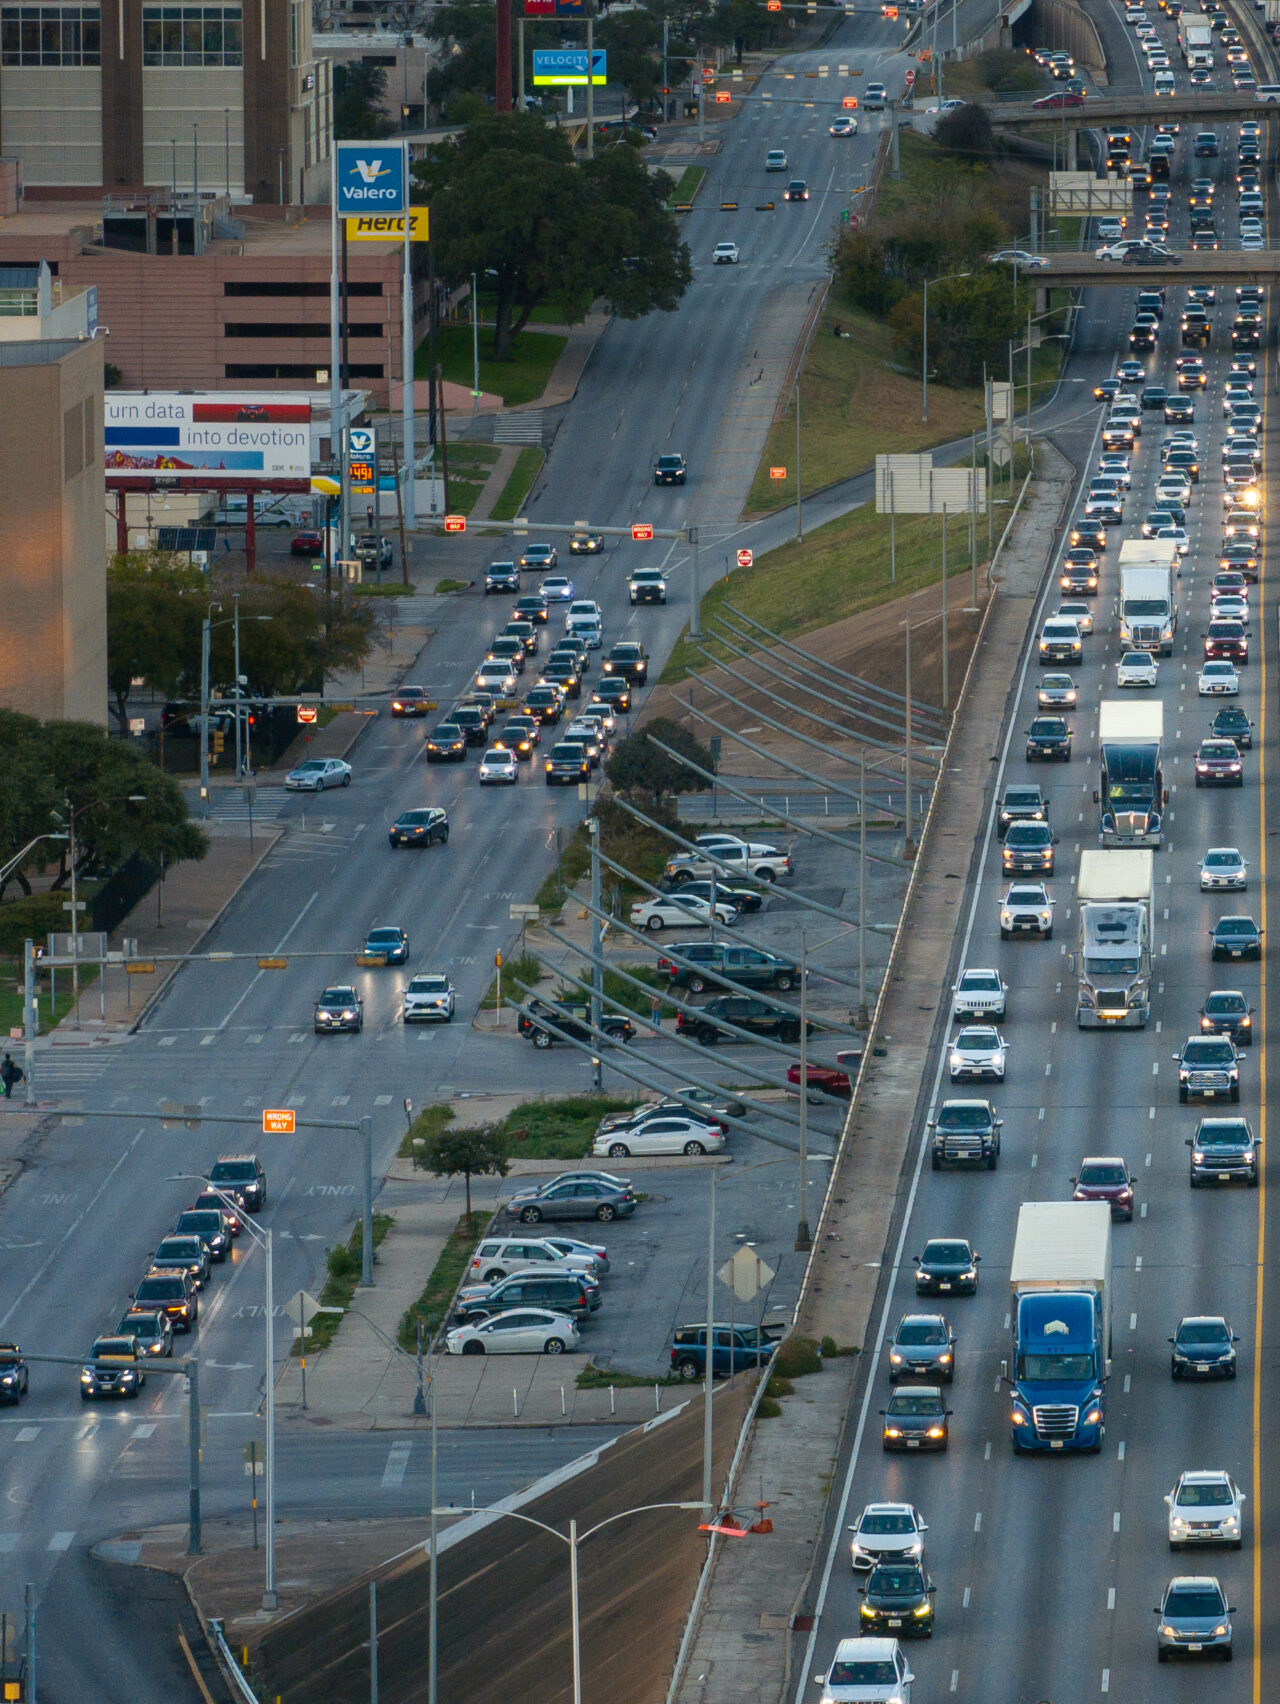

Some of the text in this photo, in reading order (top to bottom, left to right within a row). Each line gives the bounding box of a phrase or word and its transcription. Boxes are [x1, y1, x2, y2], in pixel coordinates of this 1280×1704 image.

[536, 56, 589, 65] VELOCITY
[343, 187, 397, 199] Valero
[357, 217, 419, 231] Hertz
[105, 402, 185, 419] urn data
[187, 427, 305, 446] into devotion
[266, 1113, 292, 1121] WRONG
[270, 1121, 288, 1129] WAY
